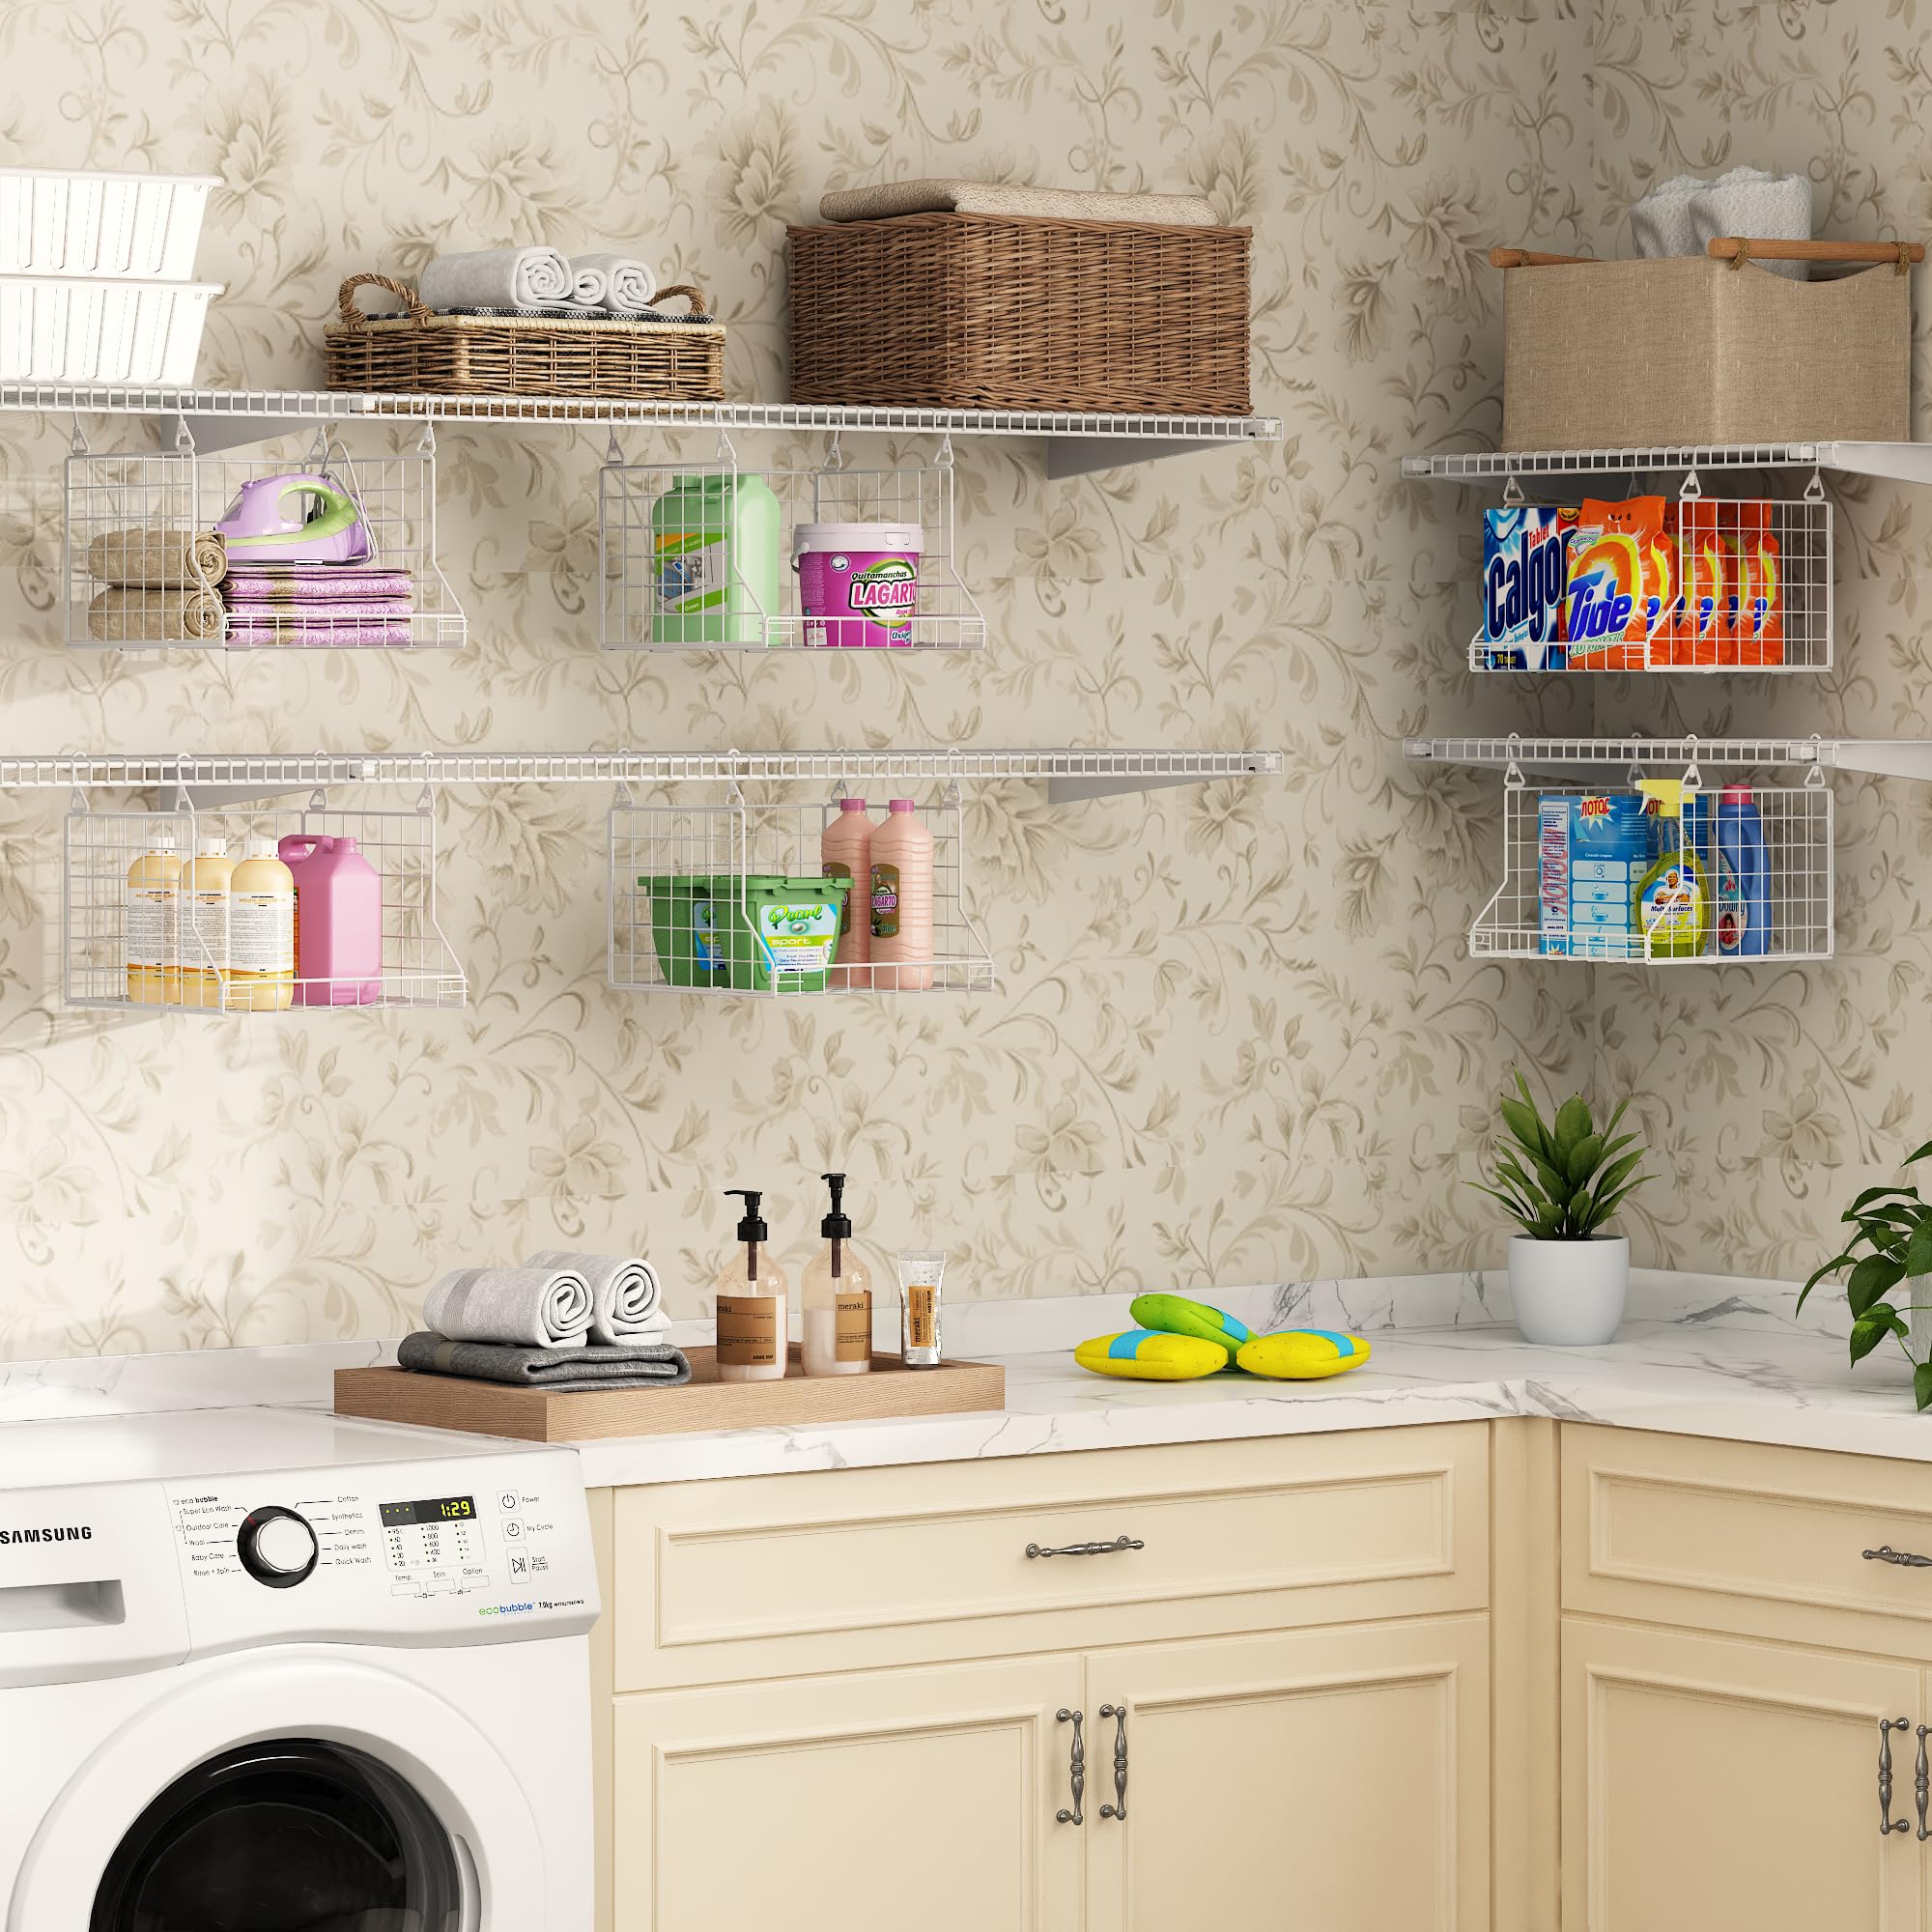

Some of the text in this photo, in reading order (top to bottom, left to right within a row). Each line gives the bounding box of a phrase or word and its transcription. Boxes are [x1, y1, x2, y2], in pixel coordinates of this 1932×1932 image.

[1529, 525, 1549, 549] Tablet
[851, 571, 907, 580] Quitamanchas
[684, 602, 700, 611] Green
[1568, 570, 1633, 650] Tide
[1581, 798, 1610, 816] ЛОТОС
[1719, 897, 1745, 916] Downy
[768, 905, 823, 930] Pearl
[771, 937, 811, 947] sport
[440, 1500, 470, 1517] 1:29
[0, 1526, 92, 1545] SAMSUNG
